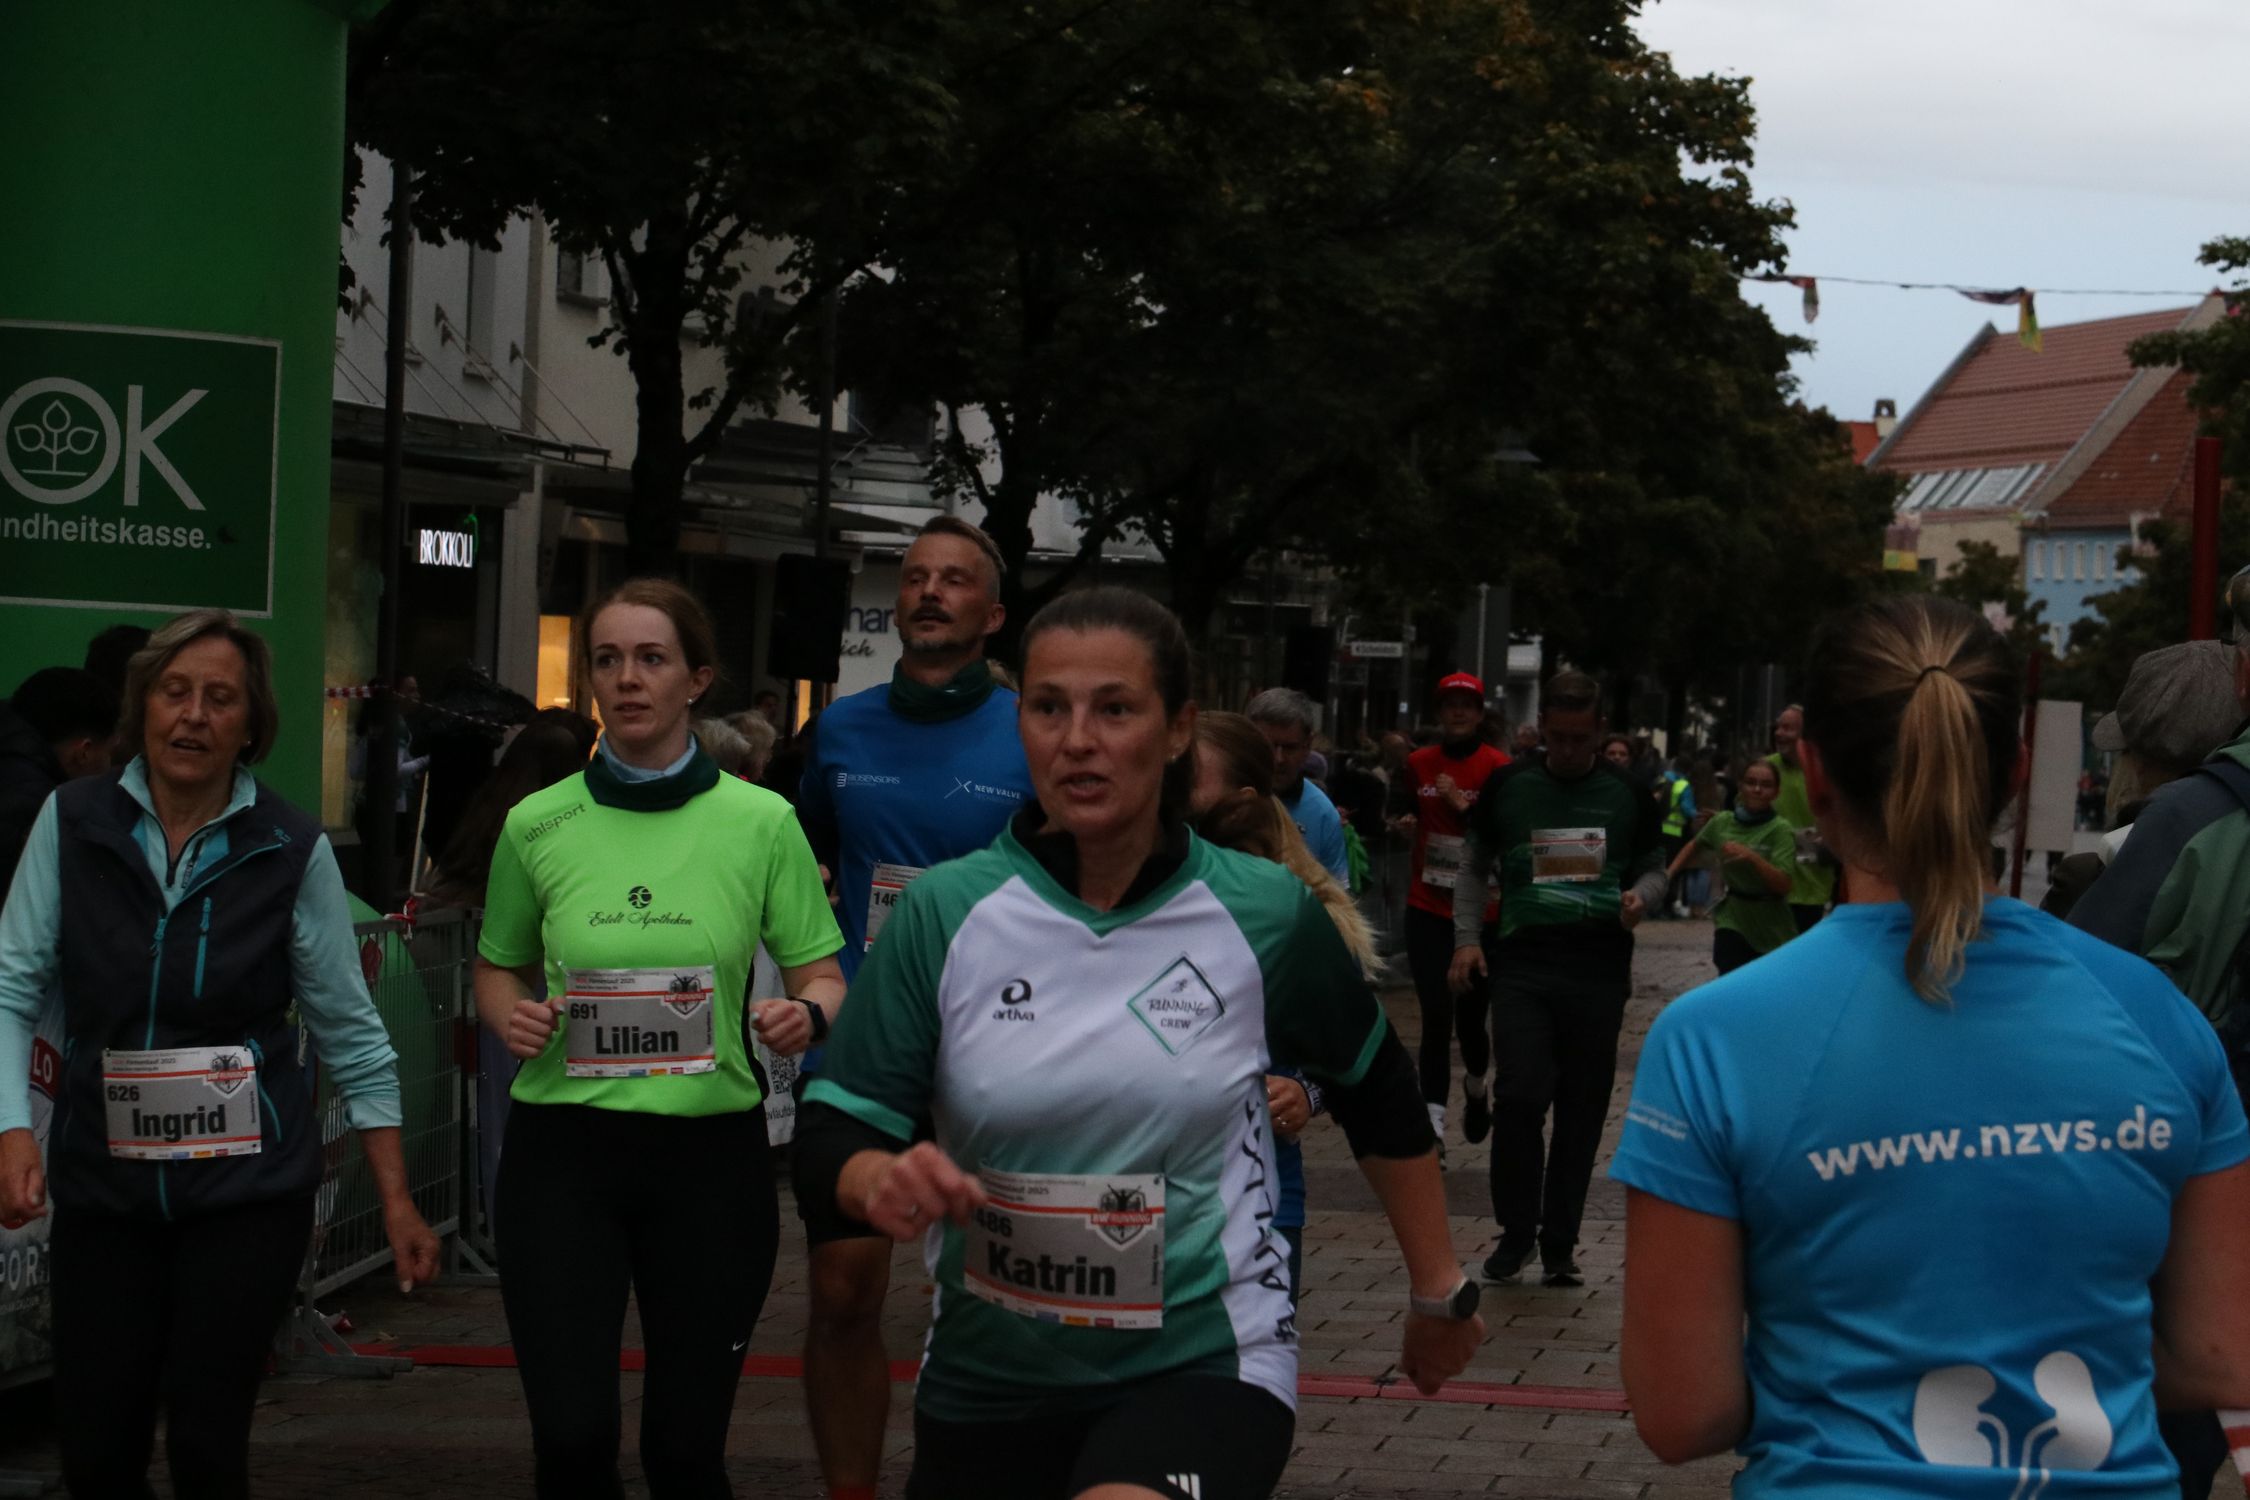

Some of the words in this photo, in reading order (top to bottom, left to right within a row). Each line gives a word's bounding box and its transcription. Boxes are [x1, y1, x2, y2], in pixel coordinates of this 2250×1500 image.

[0, 512, 212, 549] ndheitskasse.
[419, 528, 474, 569] BROKKOLI
[974, 783, 995, 795] NEW
[995, 786, 1022, 800] VALVE
[524, 802, 586, 843] uhlsport
[627, 911, 693, 930] Apotheken
[570, 1003, 598, 1019] 691
[992, 1008, 1035, 1022] artiva
[1148, 998, 1208, 1016] RUNNING
[1160, 1017, 1192, 1030] CREW
[595, 1026, 679, 1055] Lilian
[107, 1085, 140, 1102] 626
[132, 1104, 227, 1142] Ingrid
[1807, 1103, 2173, 1182] www.nzvs.de
[987, 1240, 1116, 1297] Katrin
